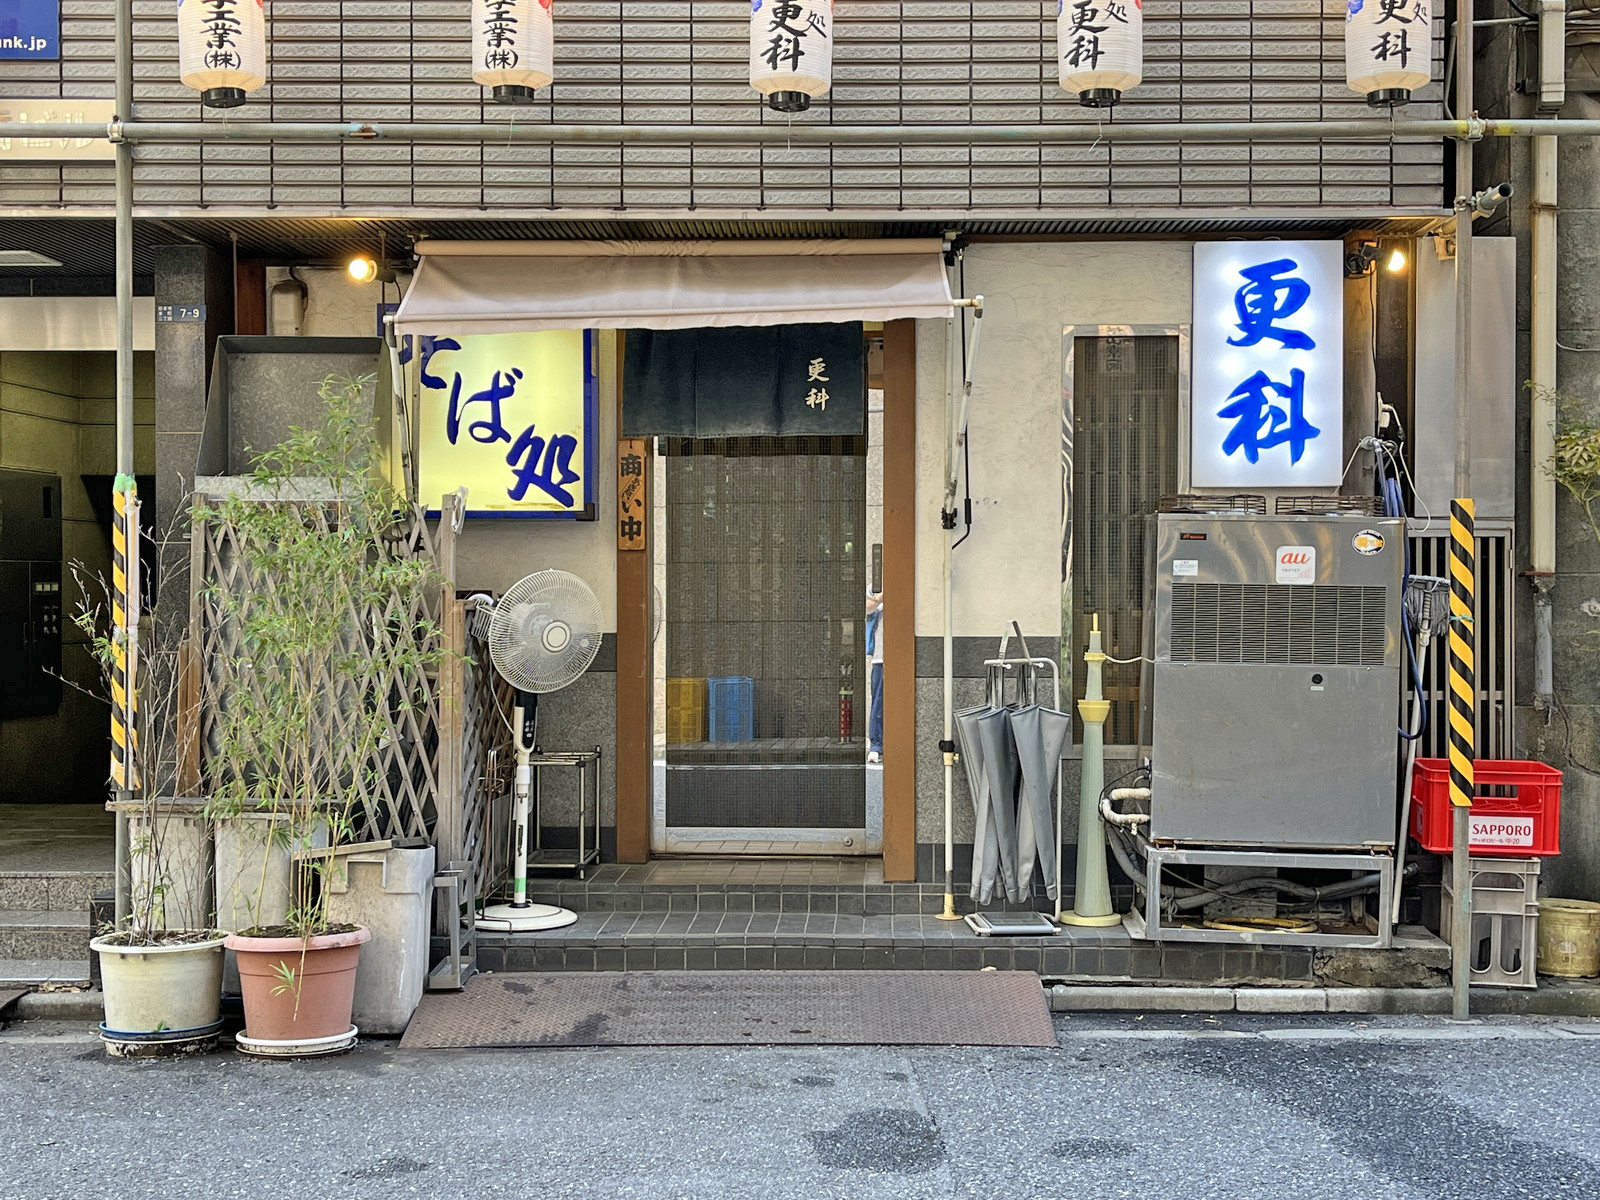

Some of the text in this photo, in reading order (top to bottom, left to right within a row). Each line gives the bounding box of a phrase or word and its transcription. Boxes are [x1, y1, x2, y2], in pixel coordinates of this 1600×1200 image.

[1063, 0, 1110, 71] 更科
[180, 308, 200, 318] 7-9
[1216, 258, 1321, 468] 更科
[804, 357, 830, 411] 更科
[1281, 552, 1311, 565] au
[1472, 823, 1531, 837] SAPPORO
